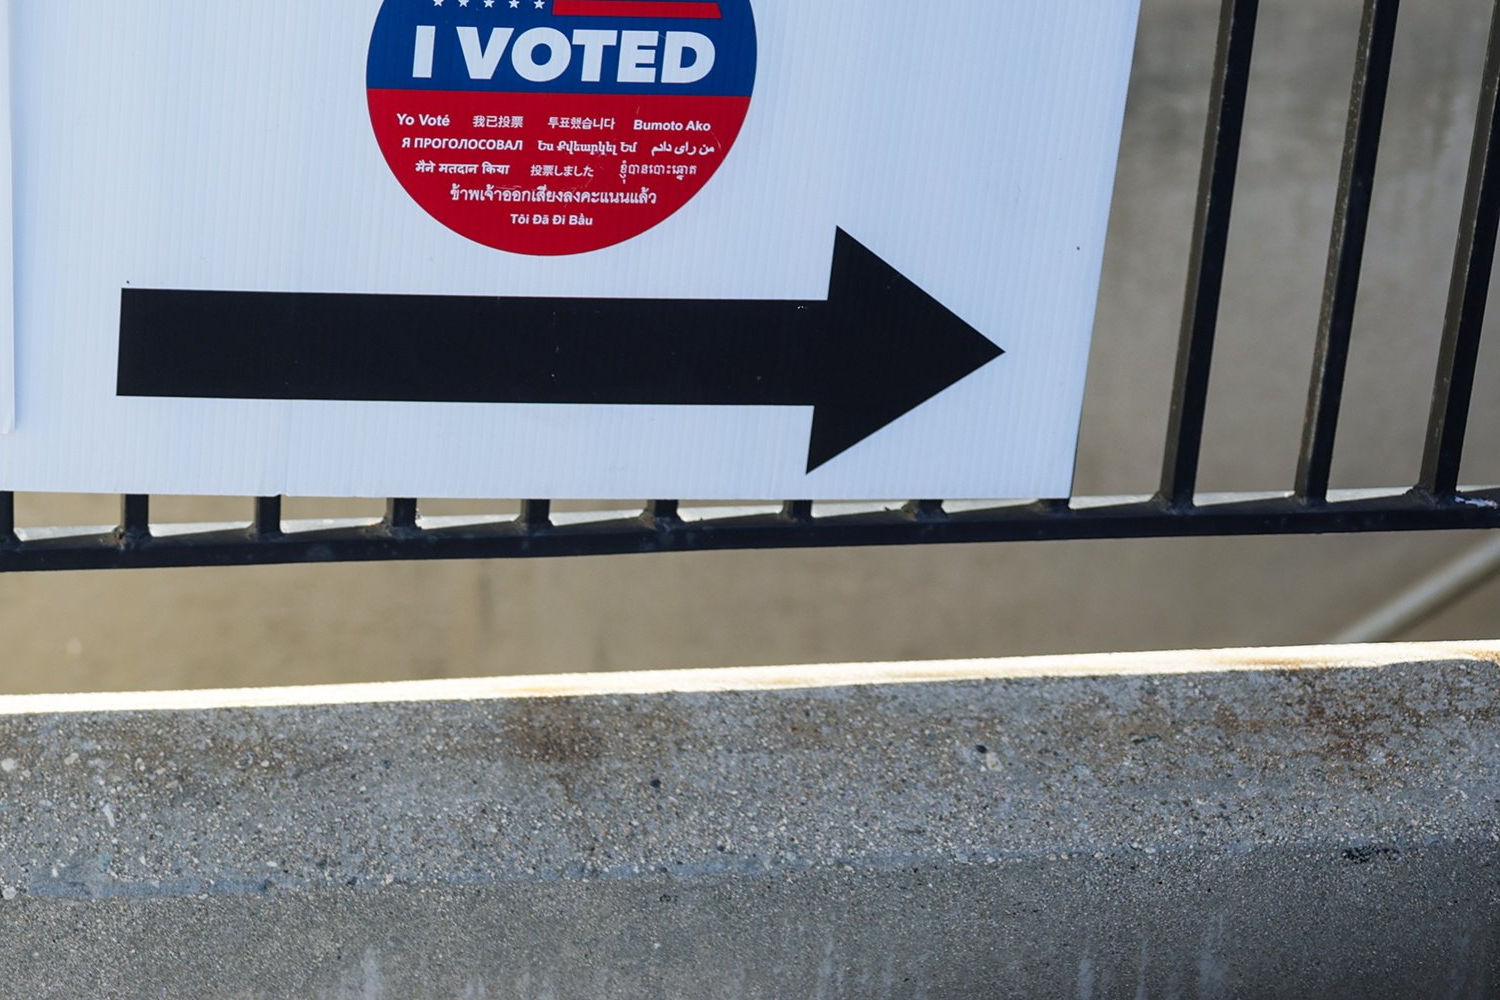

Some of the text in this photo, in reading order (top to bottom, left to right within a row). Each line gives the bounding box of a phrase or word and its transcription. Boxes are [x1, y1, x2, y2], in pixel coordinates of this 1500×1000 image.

[413, 26, 715, 83] I VOTED
[397, 113, 450, 126] Yo Voté
[473, 115, 523, 128] 我已投票
[634, 120, 711, 131] Bumoto Ako
[402, 137, 523, 150] Я ПРОГОЛОСОВАЛ
[531, 165, 593, 177] 投票しました
[510, 214, 529, 224] Tôi
[552, 215, 565, 224] Đi
